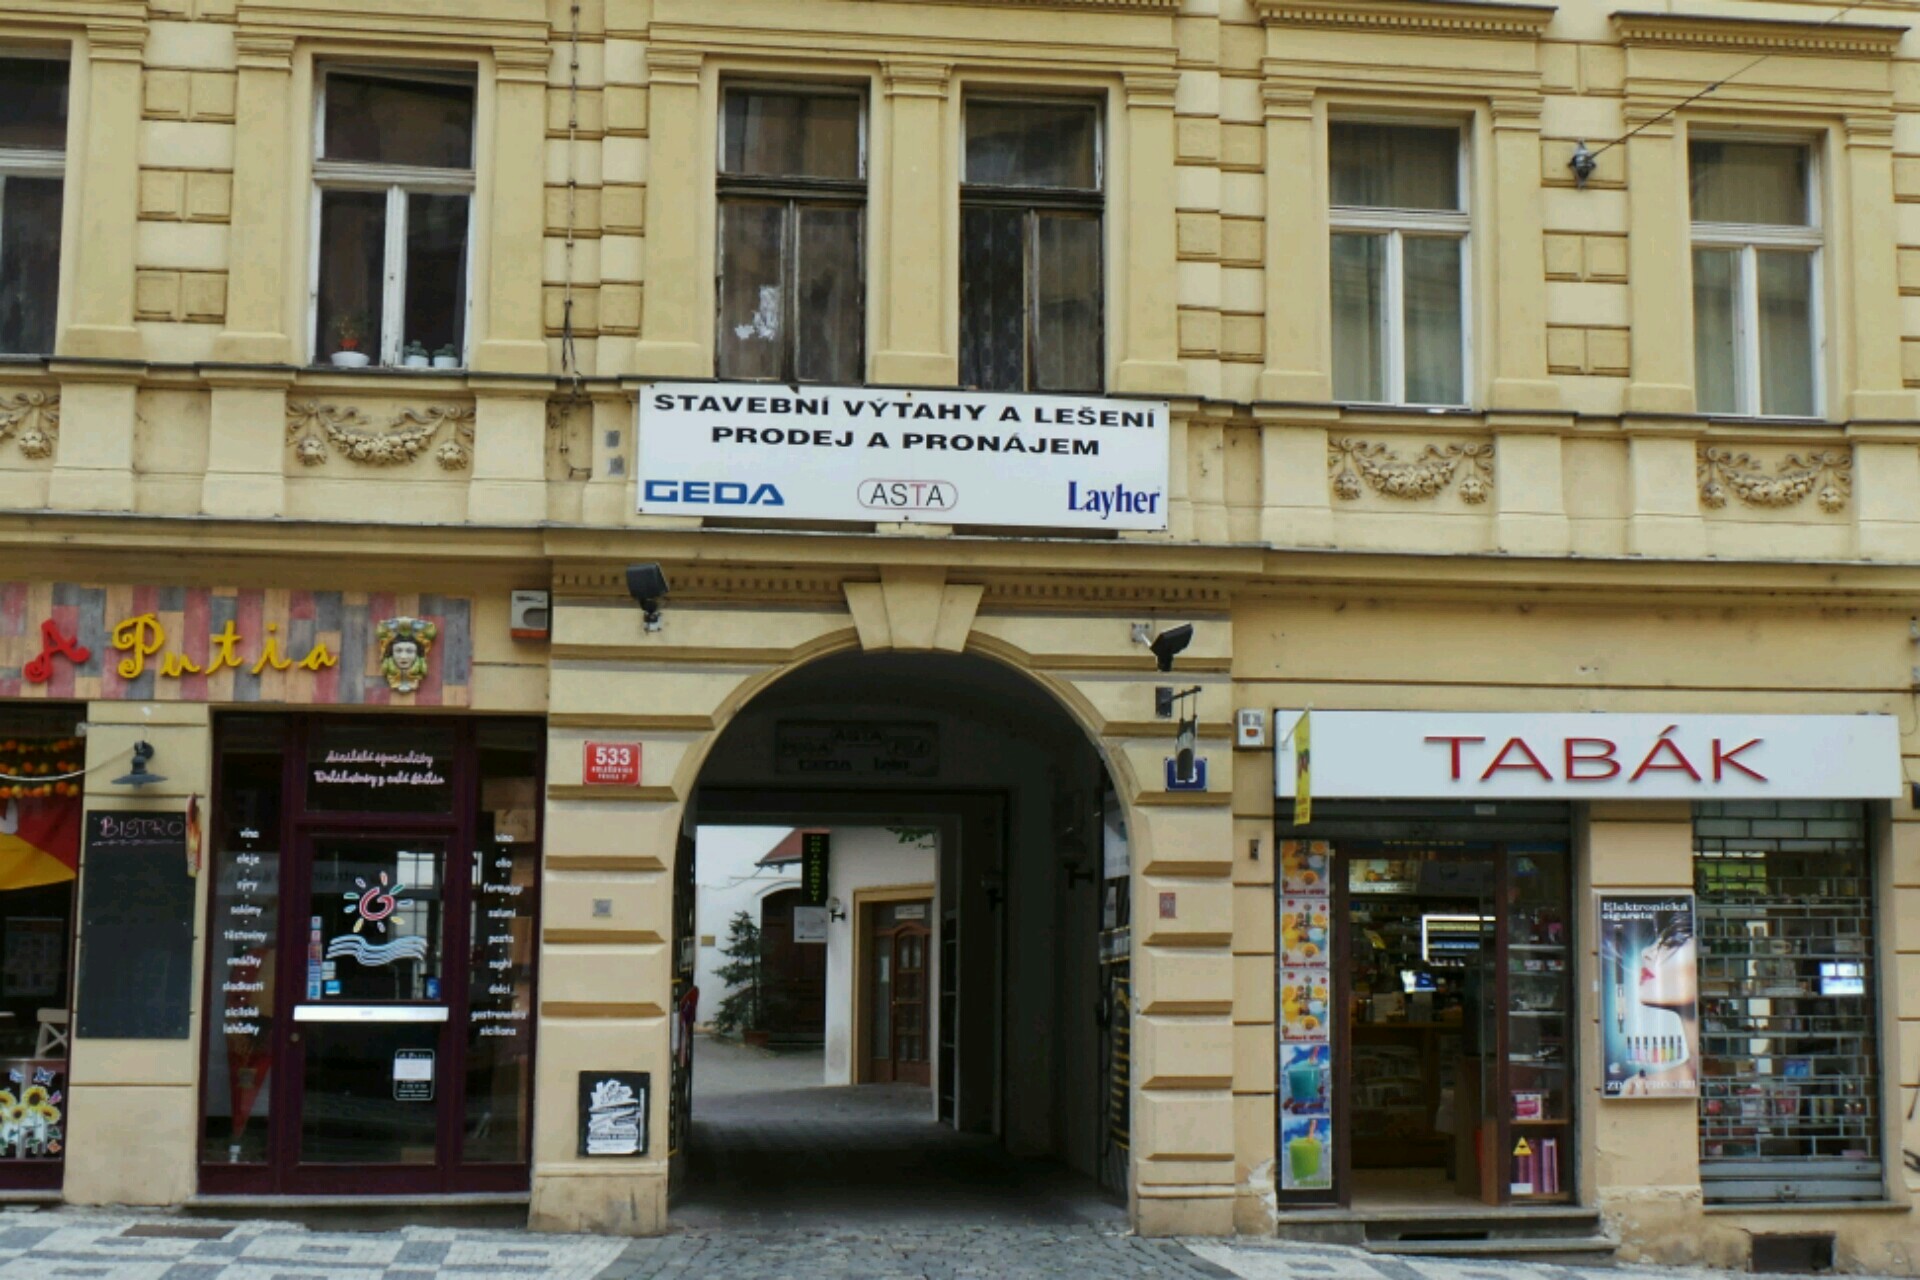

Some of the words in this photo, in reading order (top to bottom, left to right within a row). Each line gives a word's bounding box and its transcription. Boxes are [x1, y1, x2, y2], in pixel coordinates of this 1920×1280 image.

[654, 394, 829, 416] STAVEBNÍ
[843, 398, 986, 421] VÝTAHY
[999, 406, 1021, 422] A
[1034, 406, 1155, 428] LEŠENÍ
[711, 426, 854, 447] PRODEJ
[866, 432, 890, 449] A
[902, 433, 1100, 456] PRONÁJEM
[644, 480, 785, 506] GEDA
[870, 482, 945, 507] ASTA
[1067, 481, 1160, 519] Layher
[24, 619, 90, 683] A
[111, 612, 338, 679] Putia
[596, 747, 630, 765] 533
[1424, 724, 1768, 782] TABÁK
[100, 815, 184, 838] BISTRO
[1603, 902, 1689, 912] Elektronická
